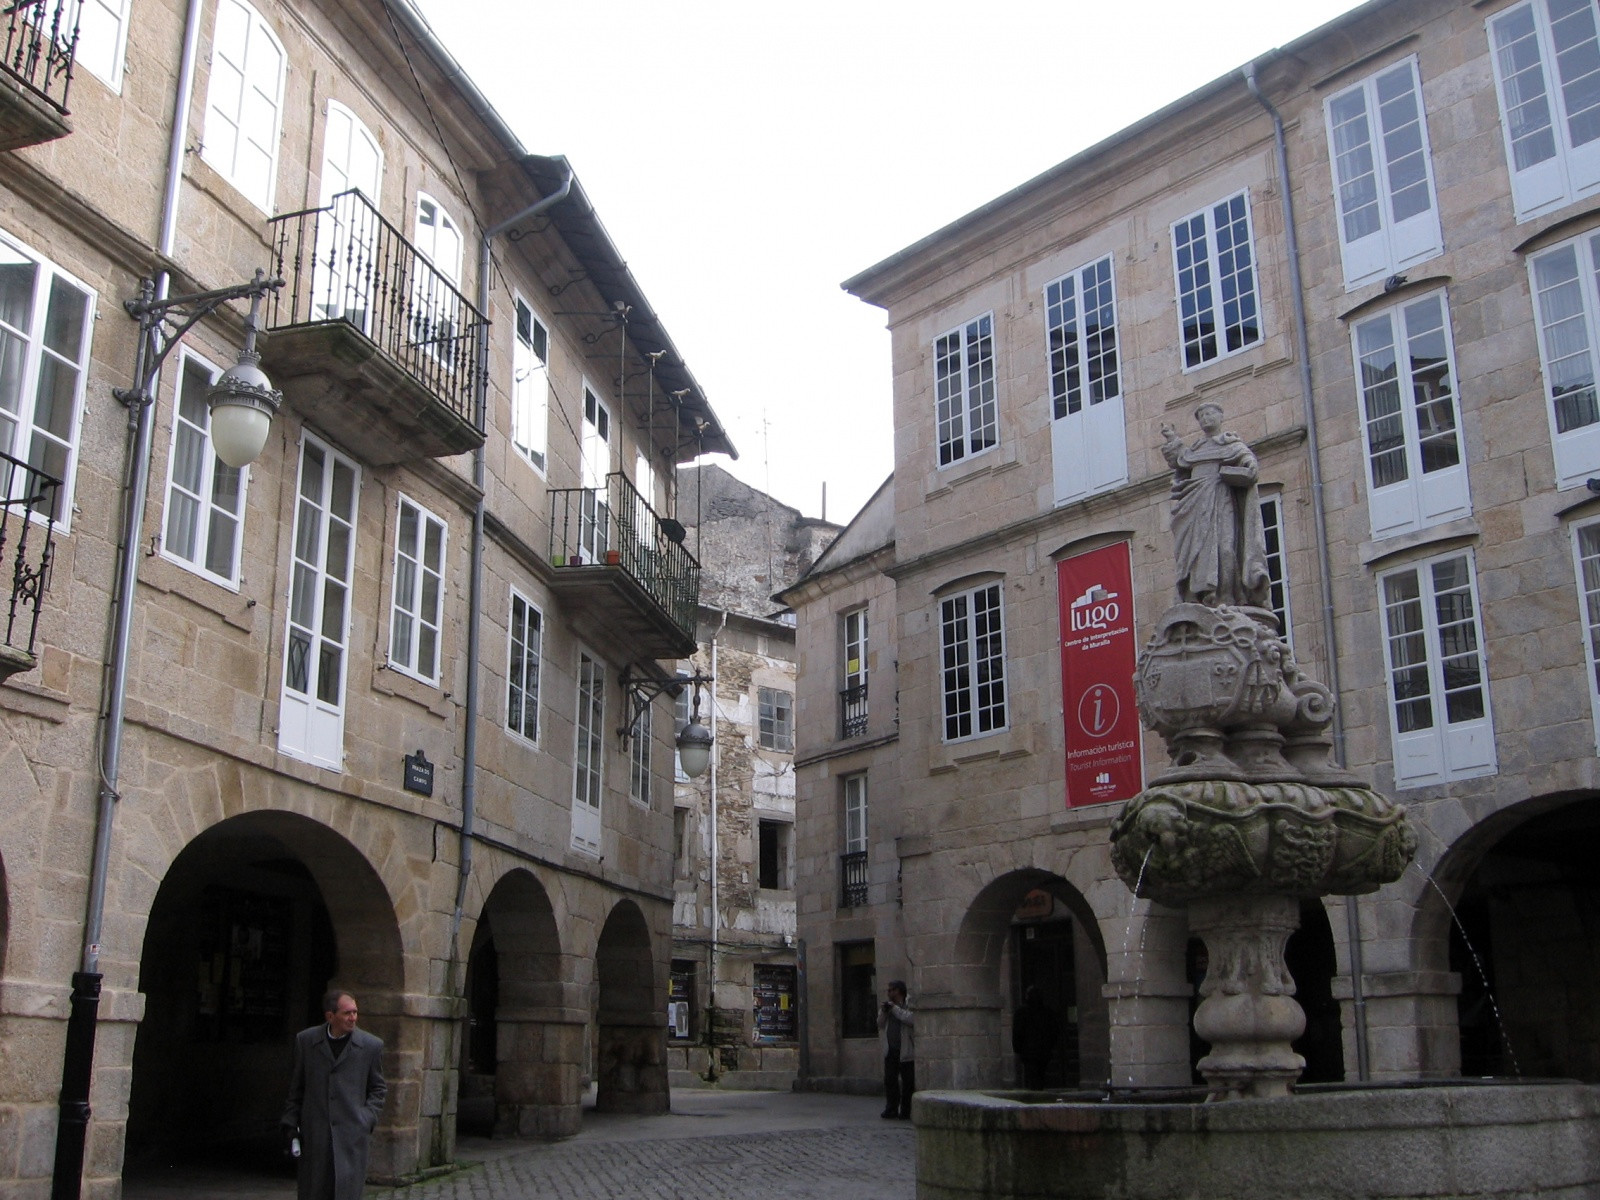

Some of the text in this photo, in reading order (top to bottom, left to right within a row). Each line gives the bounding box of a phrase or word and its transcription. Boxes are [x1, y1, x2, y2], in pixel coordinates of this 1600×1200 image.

[1071, 602, 1119, 631] lugo
[1065, 639, 1081, 647] Centro
[1090, 639, 1110, 648] Muralla
[1068, 740, 1134, 759] Información turística
[1071, 760, 1091, 771] Tourist
